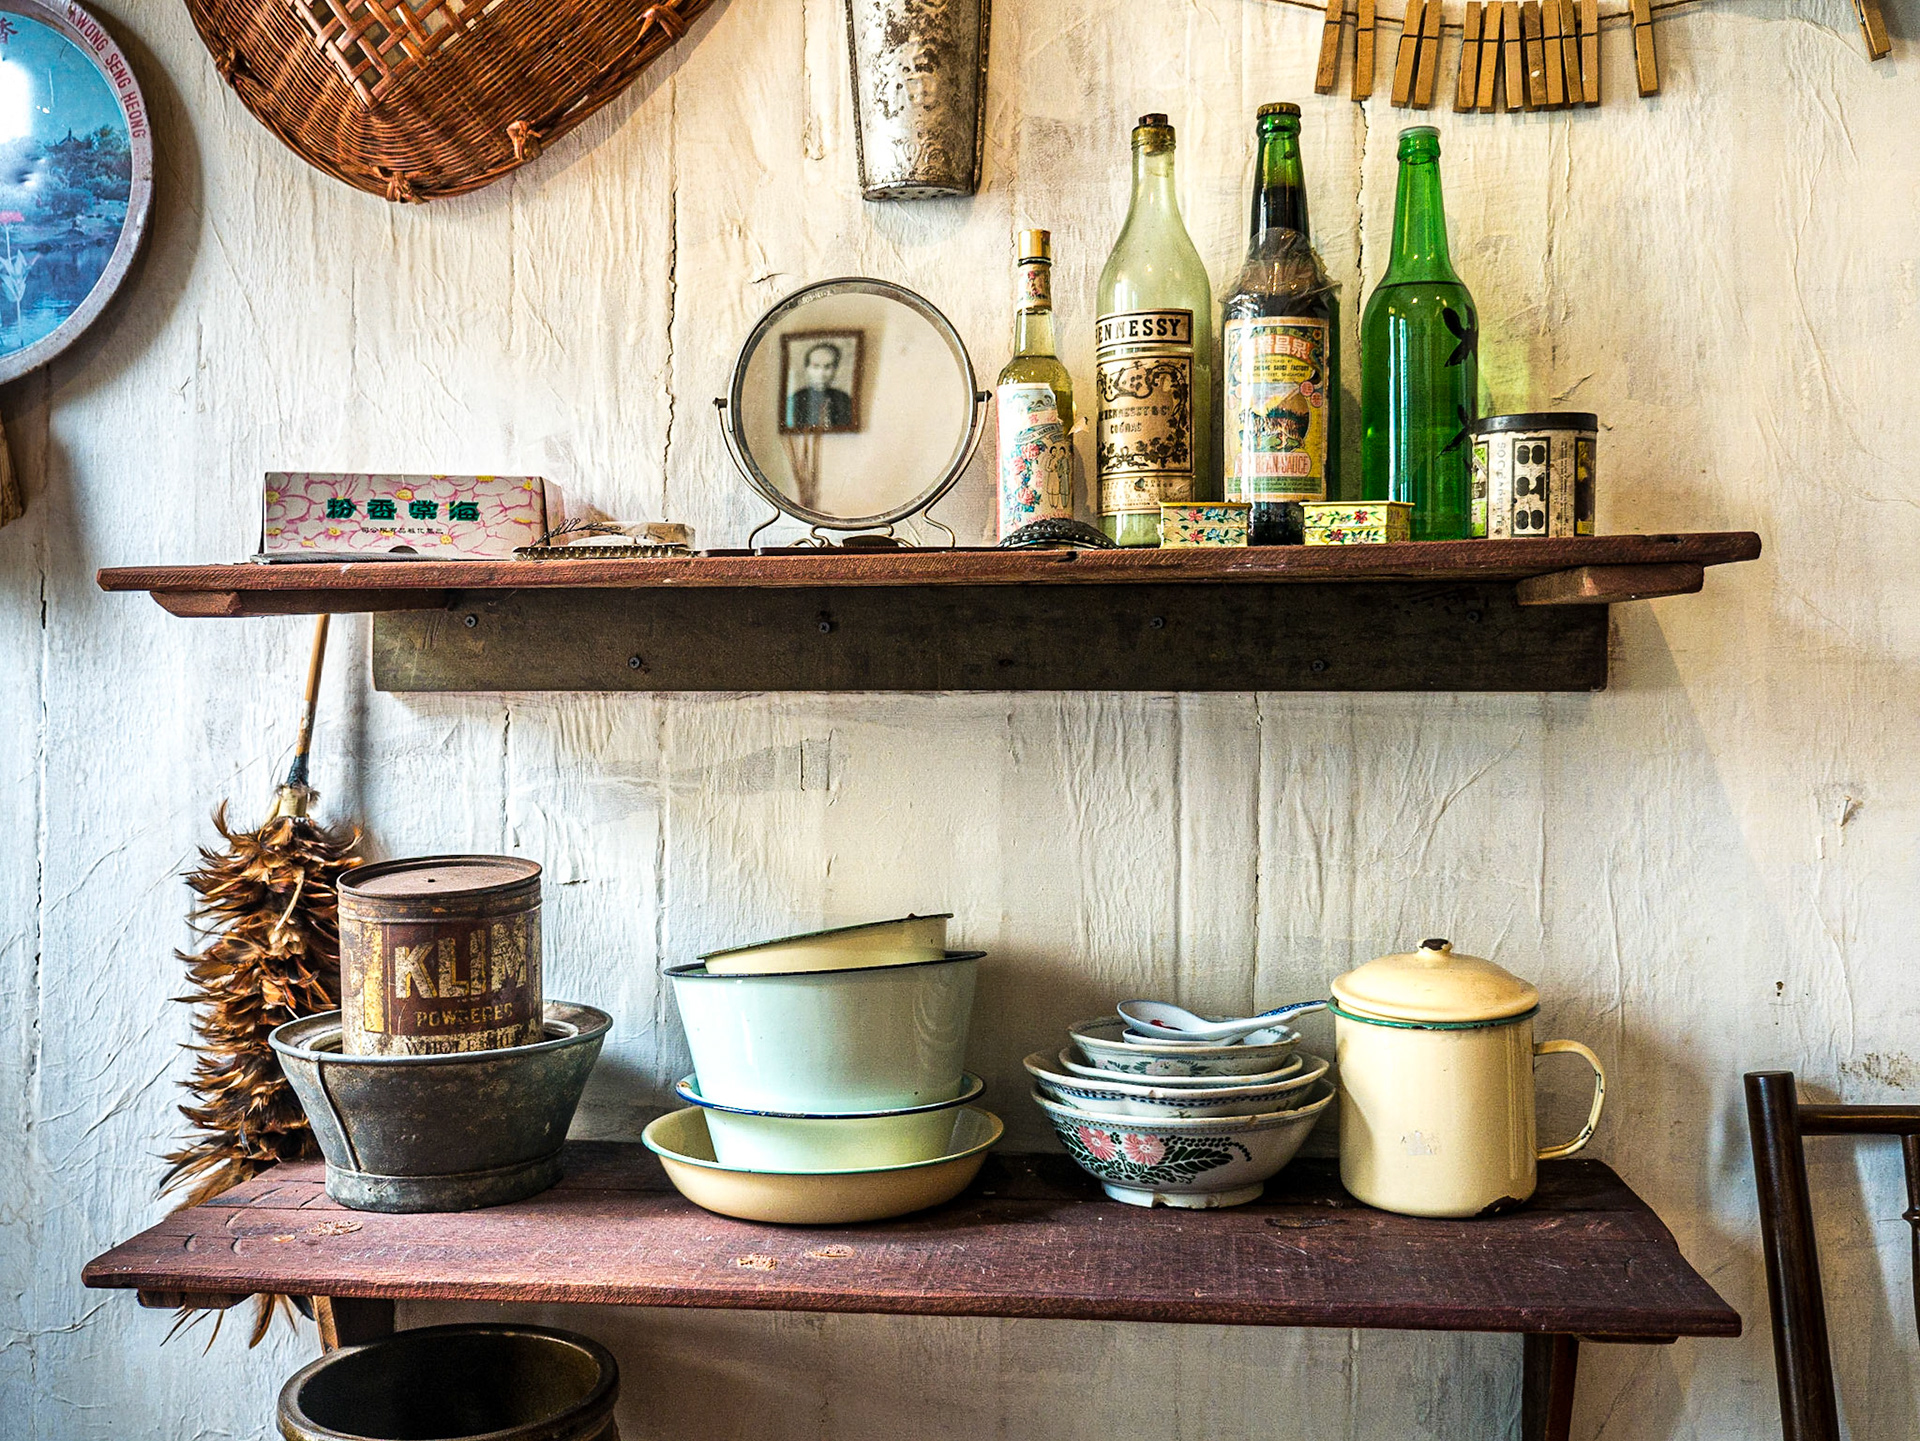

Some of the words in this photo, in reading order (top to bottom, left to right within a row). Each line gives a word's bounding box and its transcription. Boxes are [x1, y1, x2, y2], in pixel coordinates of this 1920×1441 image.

[68, 5, 109, 52] KWONG
[105, 53, 132, 89] SENG
[123, 91, 147, 139] HEONG
[1256, 455, 1279, 474] BEAN
[1281, 455, 1308, 475] SAUCE
[394, 917, 528, 999] KLIM
